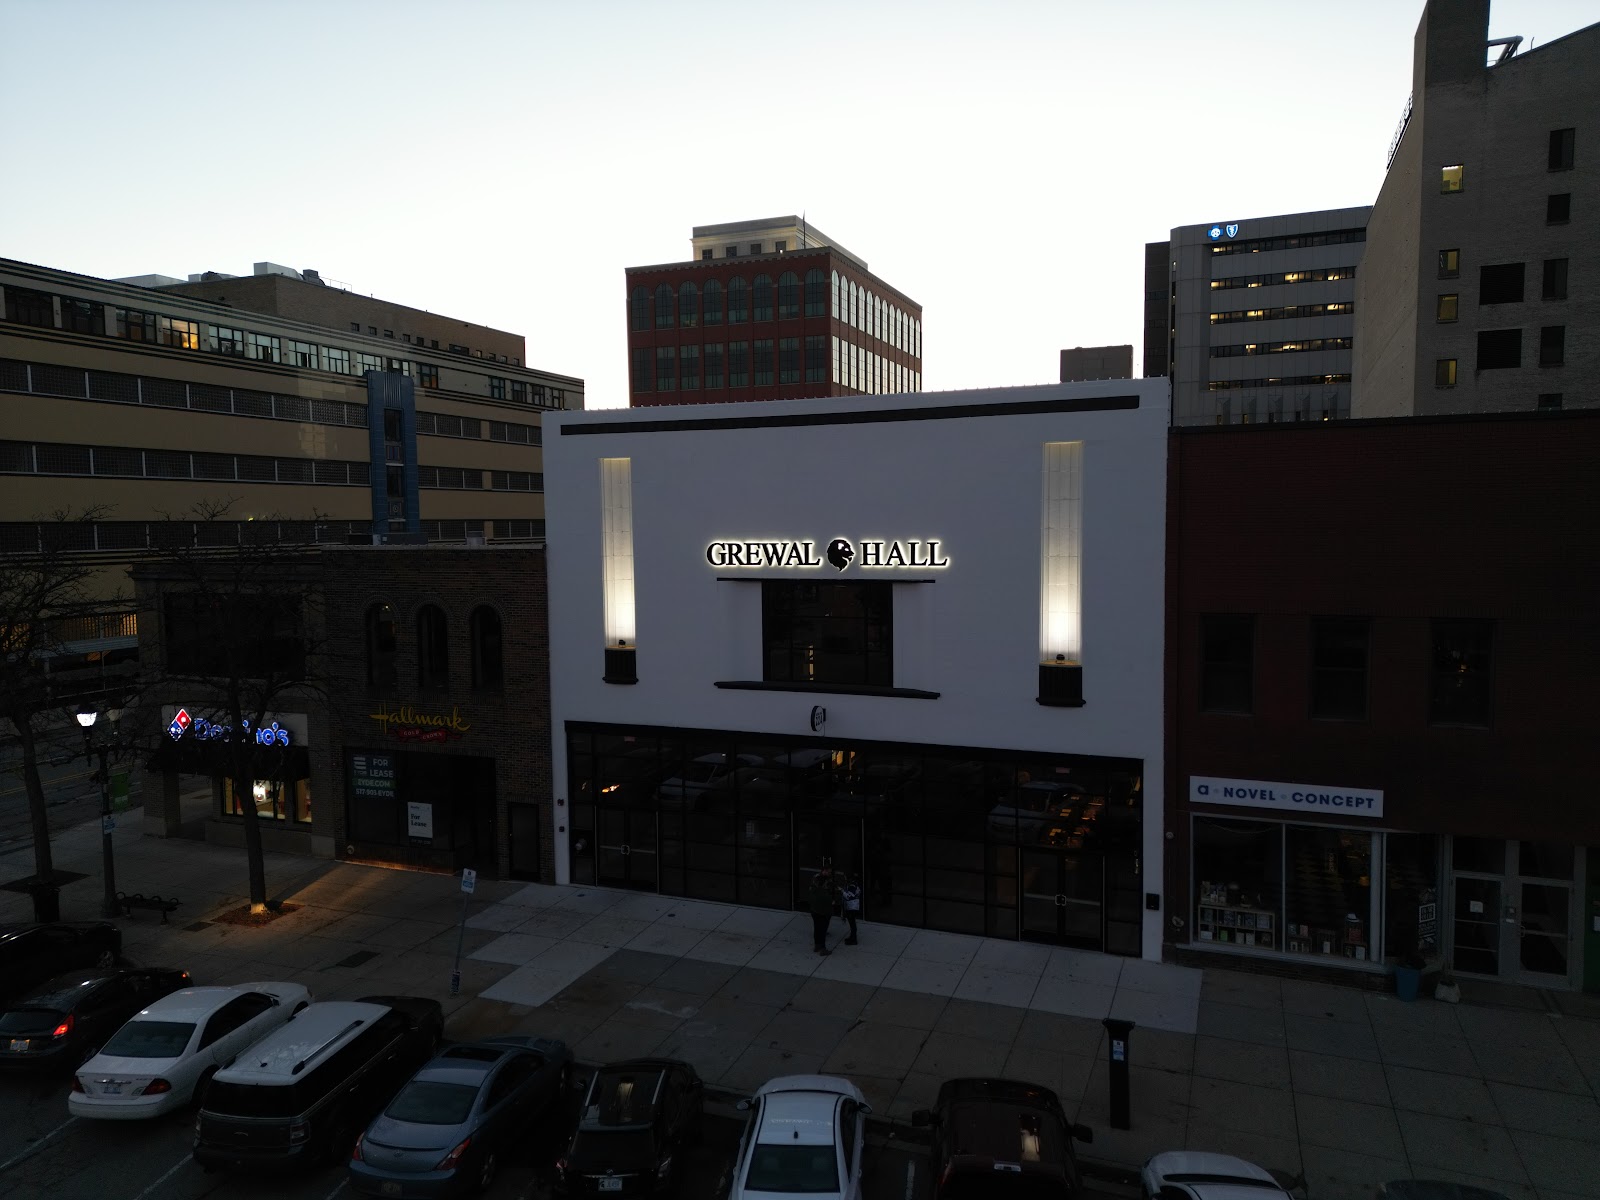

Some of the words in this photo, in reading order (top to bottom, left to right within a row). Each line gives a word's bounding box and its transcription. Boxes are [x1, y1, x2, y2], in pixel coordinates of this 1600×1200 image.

[706, 542, 821, 566] GREWAL
[859, 541, 948, 566] HALL
[368, 701, 472, 734] Hallmark
[369, 769, 394, 778] LEASE
[372, 758, 388, 767] FOR
[1223, 786, 1276, 801] NOVEL
[1291, 791, 1374, 809] CONCEPT
